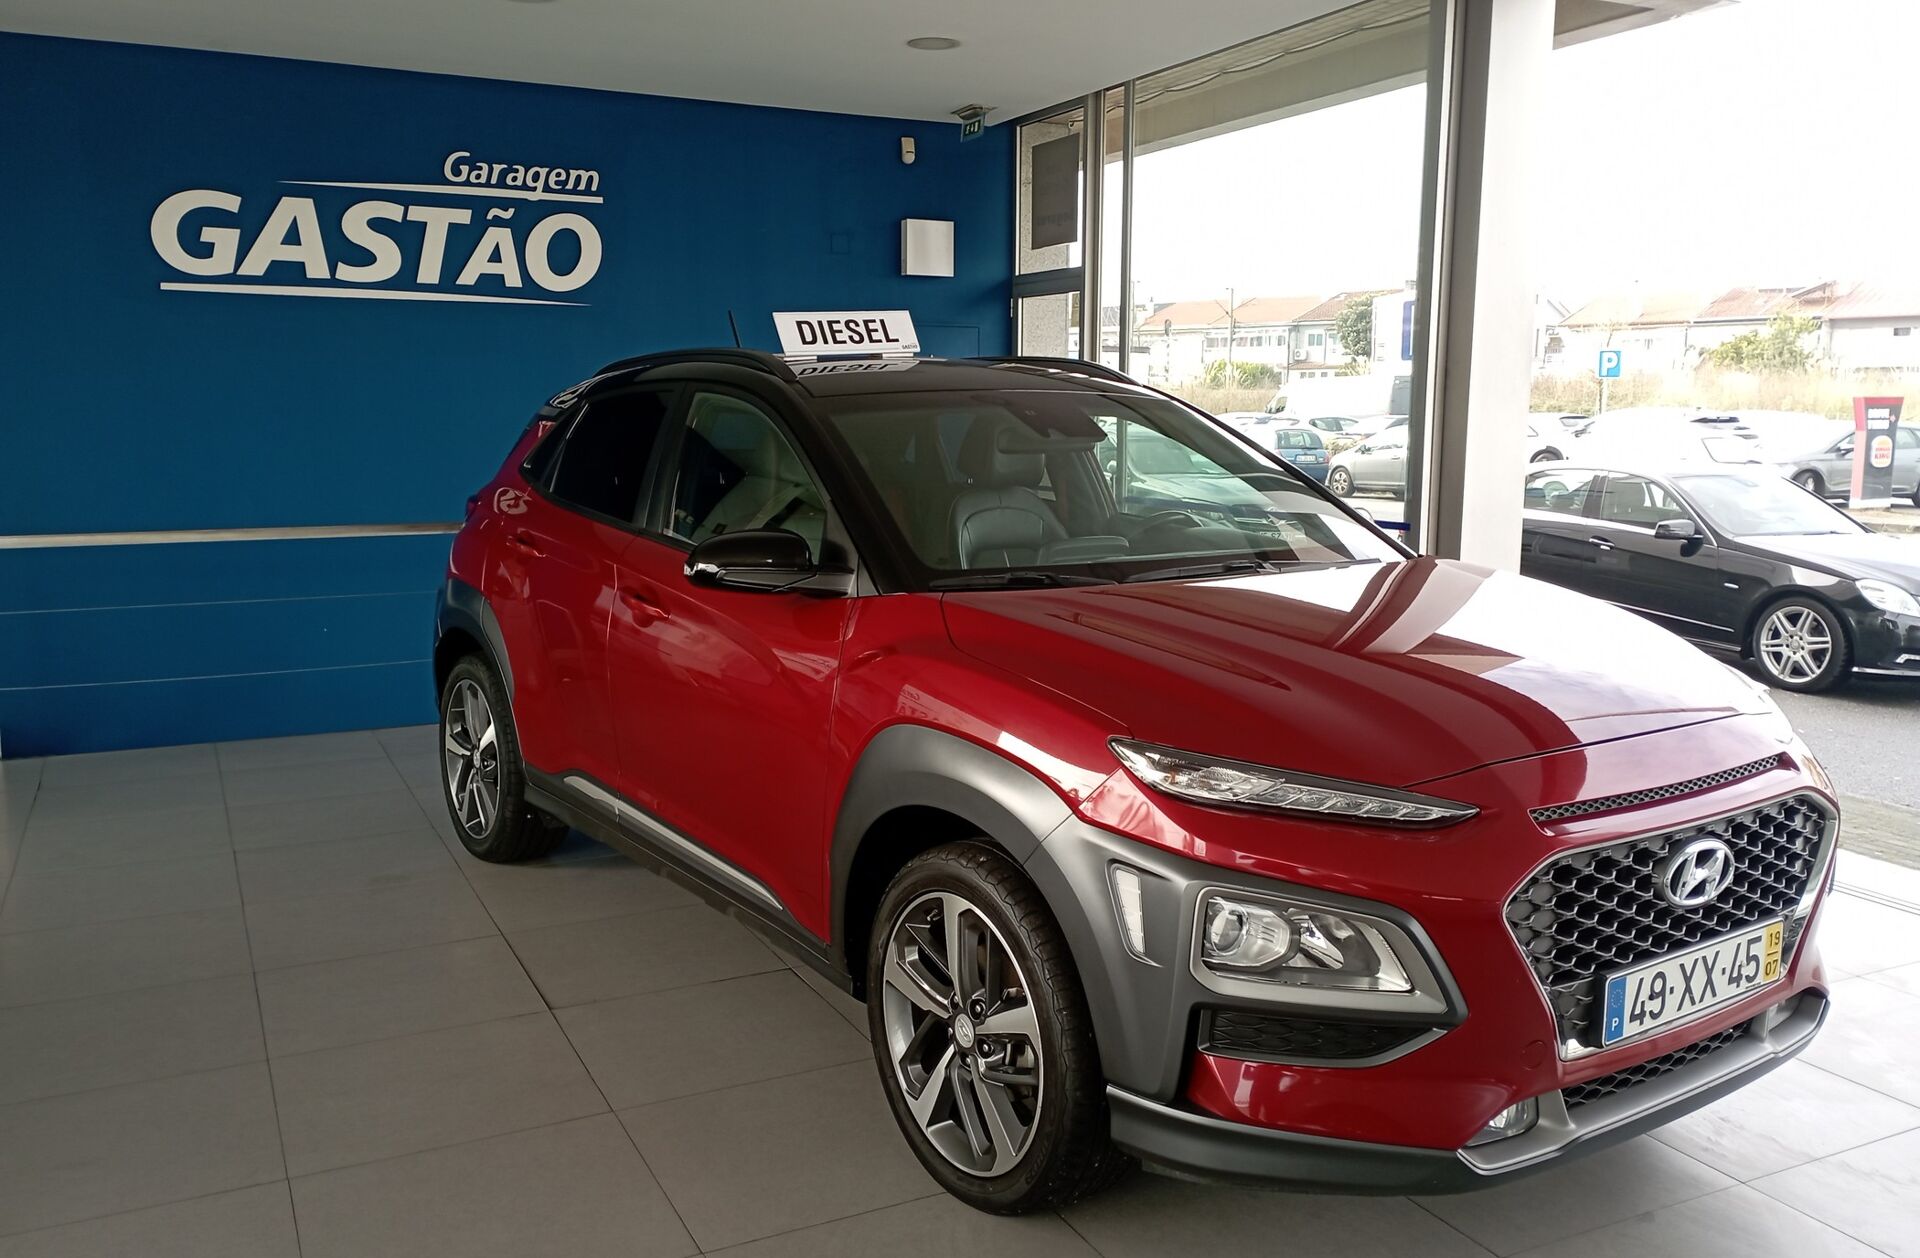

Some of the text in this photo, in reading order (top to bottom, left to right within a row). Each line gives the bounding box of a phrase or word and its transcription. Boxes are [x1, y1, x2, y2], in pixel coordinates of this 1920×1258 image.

[444, 151, 600, 201] Garagem
[150, 189, 603, 293] GASTÃO
[795, 319, 899, 345] DIESEL
[1600, 351, 1619, 377] P
[1768, 931, 1781, 948] 19
[1765, 959, 1779, 976] 07
[1611, 1018, 1619, 1032] P
